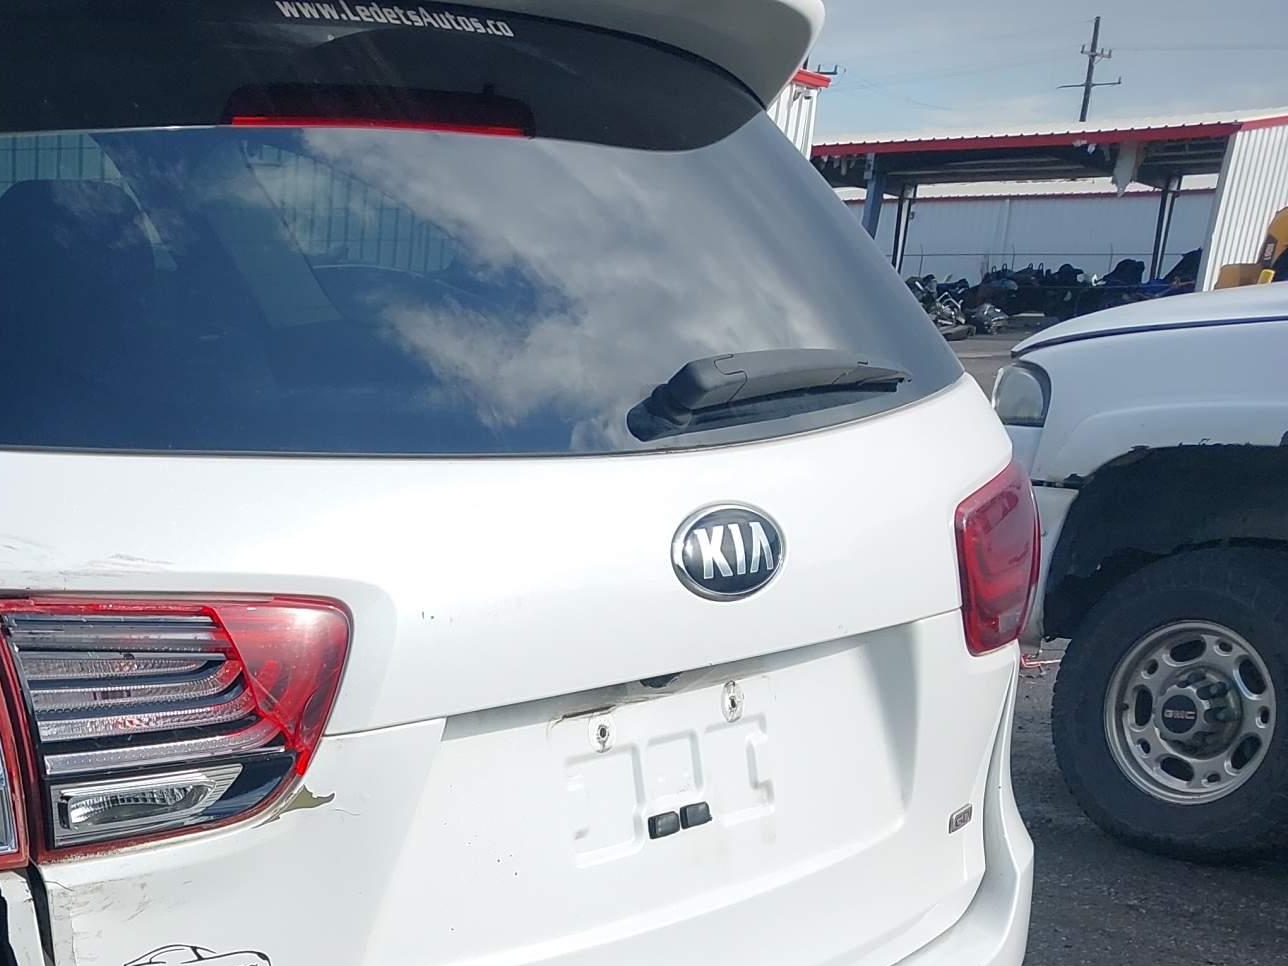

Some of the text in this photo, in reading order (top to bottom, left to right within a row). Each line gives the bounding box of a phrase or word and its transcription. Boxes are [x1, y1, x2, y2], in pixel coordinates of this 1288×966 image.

[274, 0, 514, 37] www.LedetsAutos.co
[692, 520, 775, 580] KIA
[1163, 709, 1196, 720] GMC
